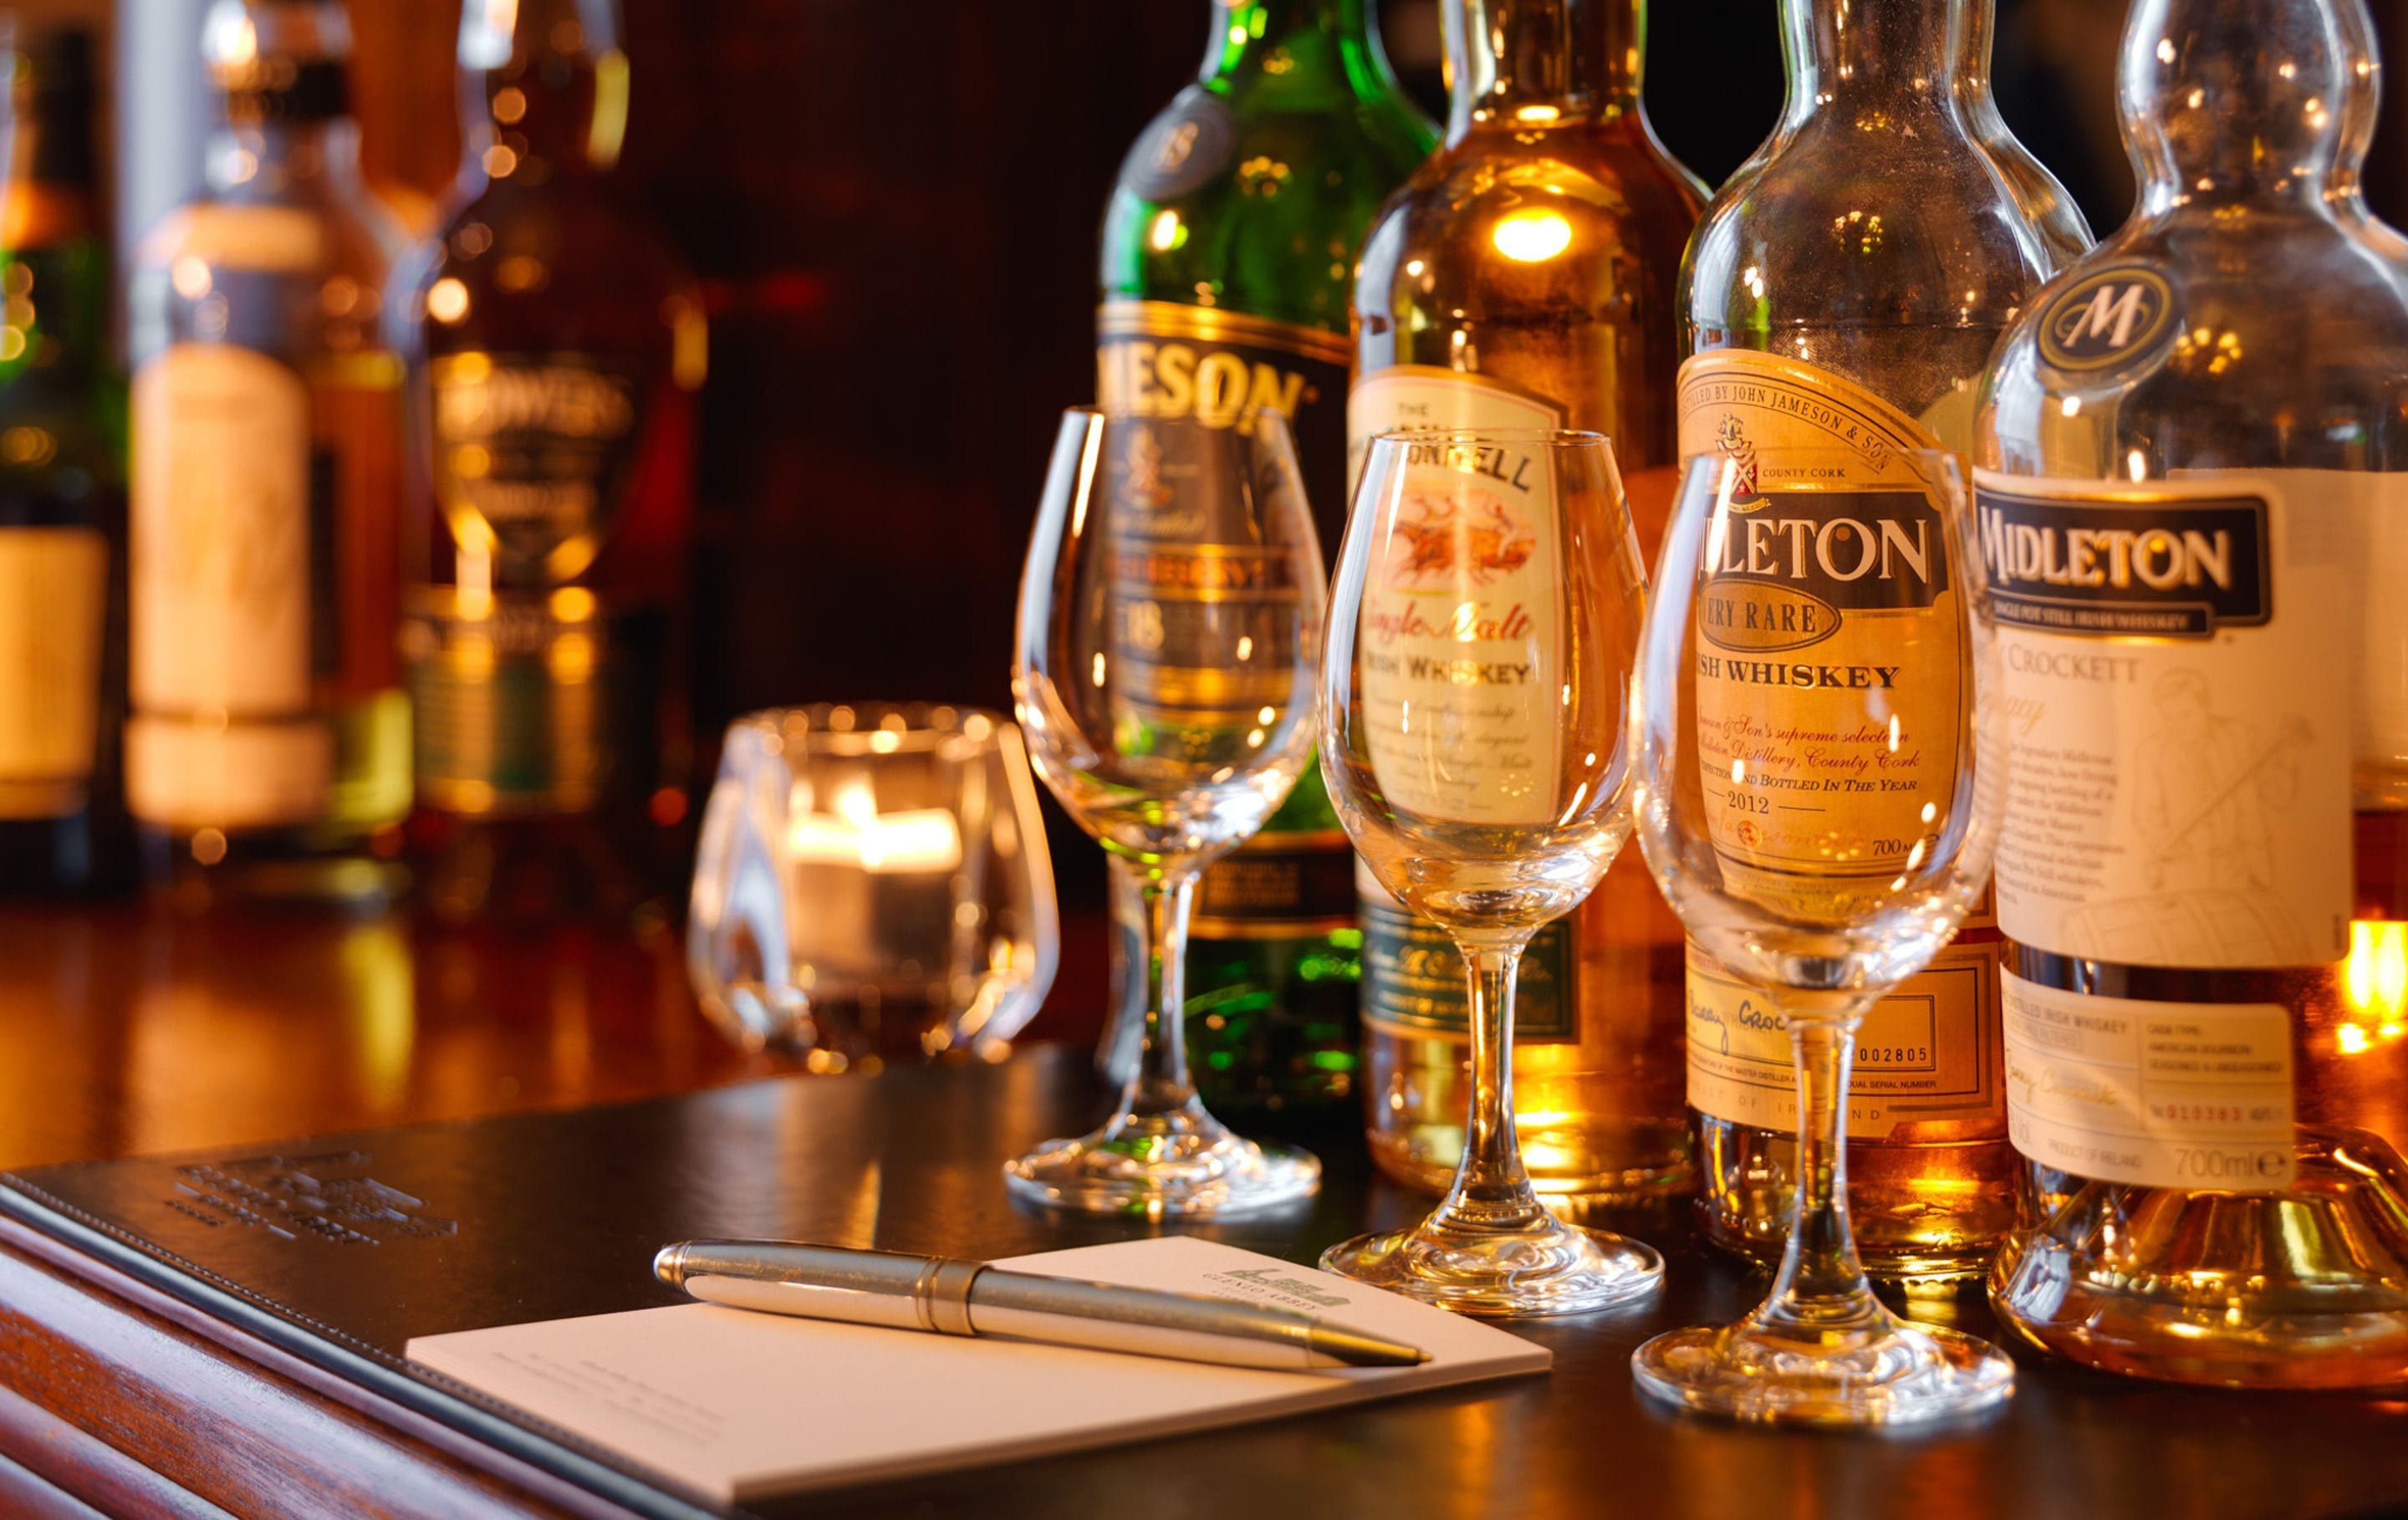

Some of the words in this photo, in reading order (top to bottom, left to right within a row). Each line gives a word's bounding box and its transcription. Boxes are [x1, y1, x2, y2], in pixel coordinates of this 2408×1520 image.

[1716, 386, 1727, 400] BY
[1733, 386, 1766, 403] JOHN
[1771, 393, 1843, 430] JAMESON
[1846, 426, 1858, 440] &
[1862, 435, 1890, 471] SON
[1763, 468, 1806, 478] COUNTY
[1810, 468, 1845, 478] CORK
[1706, 518, 1928, 584] LETON
[1980, 505, 2233, 590] MIDLETON
[1707, 597, 1735, 627] ERY
[1747, 602, 1816, 633] RARE
[1726, 659, 1900, 688] WHISKEY
[2008, 643, 2140, 682] CROCKETT
[1733, 714, 1772, 738] Son's
[1775, 727, 1838, 747] supreme
[1841, 726, 1910, 744] selectin
[1732, 738, 1801, 773] Distillery,
[1804, 747, 1870, 776] County
[1875, 748, 1920, 769] Cork
[1743, 773, 1758, 785] ND
[1760, 773, 1820, 791] BOTTLED
[1823, 779, 1840, 792] IN
[1844, 779, 1875, 792] THE
[1880, 778, 1917, 792] YEAR
[1727, 790, 1769, 814] 2012
[1860, 1048, 1927, 1063] 002805
[1736, 1067, 1757, 1079] MASTER
[1758, 1071, 1790, 1084] DISTILLER
[1870, 1080, 1898, 1089] SERIAL
[1900, 1079, 1937, 1089] NUMBER
[2176, 1148, 2255, 1178] 700ml
